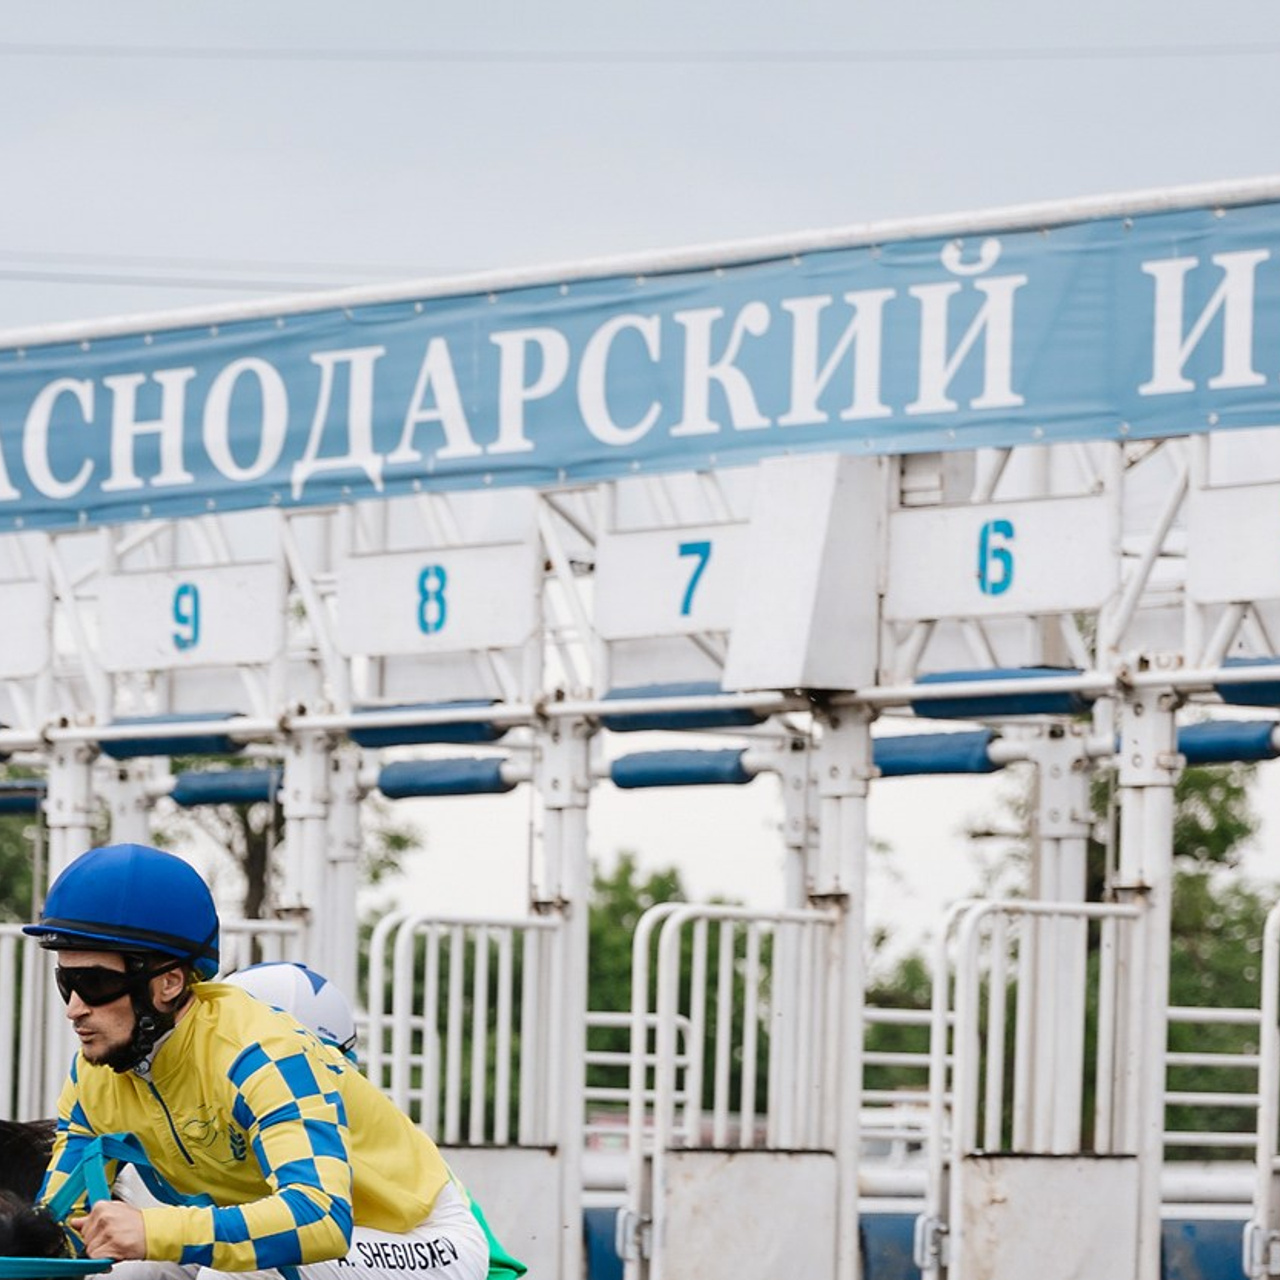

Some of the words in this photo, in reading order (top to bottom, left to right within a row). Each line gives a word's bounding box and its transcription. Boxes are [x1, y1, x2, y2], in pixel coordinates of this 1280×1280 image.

[677, 540, 713, 617] 7
[976, 517, 1016, 598] 6
[170, 582, 202, 652] 9
[416, 564, 449, 635] 8
